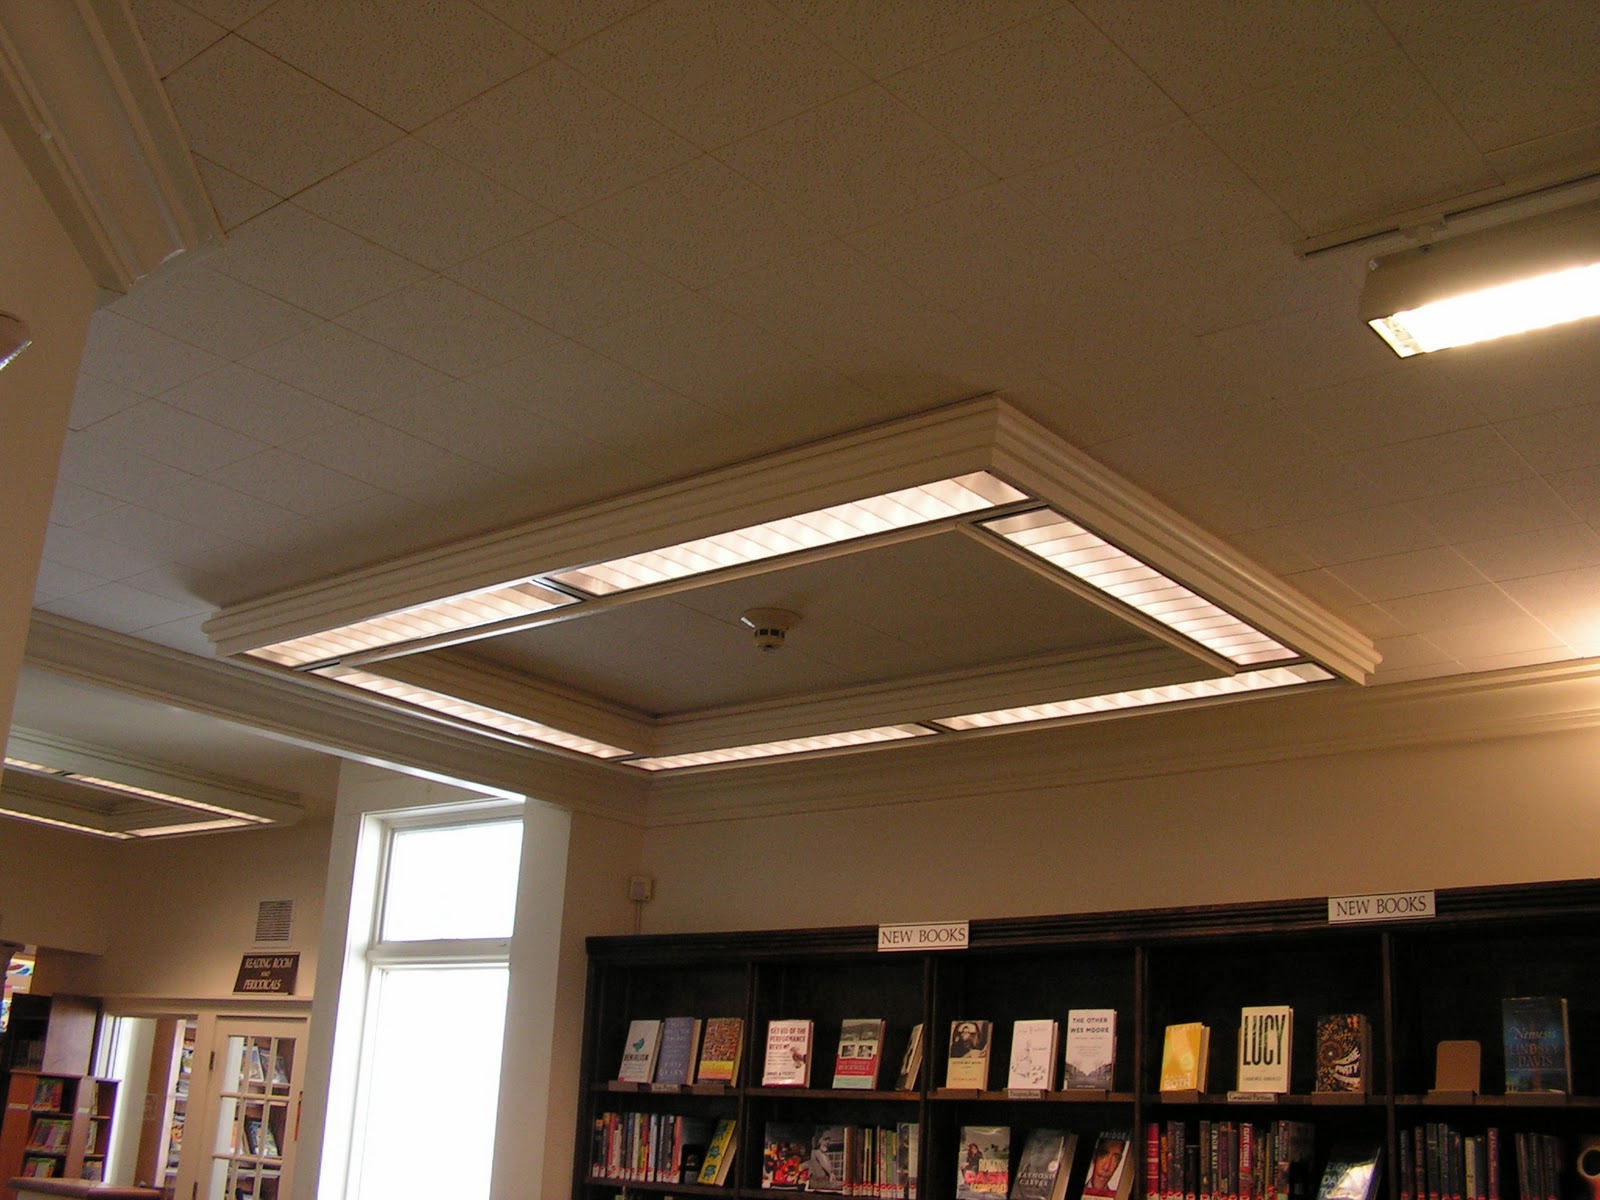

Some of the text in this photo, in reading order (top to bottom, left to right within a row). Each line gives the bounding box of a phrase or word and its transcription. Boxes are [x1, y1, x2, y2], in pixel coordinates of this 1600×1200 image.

[1336, 895, 1427, 917] NEW BOOKS
[881, 927, 966, 945] NEW BOOKS
[244, 957, 294, 969] READING ROOM
[242, 979, 282, 990] PERIODICALS
[1086, 1016, 1108, 1024] OTHER
[1085, 1026, 1110, 1034] MOORE
[1243, 1014, 1286, 1066] LUCY
[1509, 1043, 1558, 1056] LINDSEY
[1518, 1056, 1553, 1067] DAVIS
